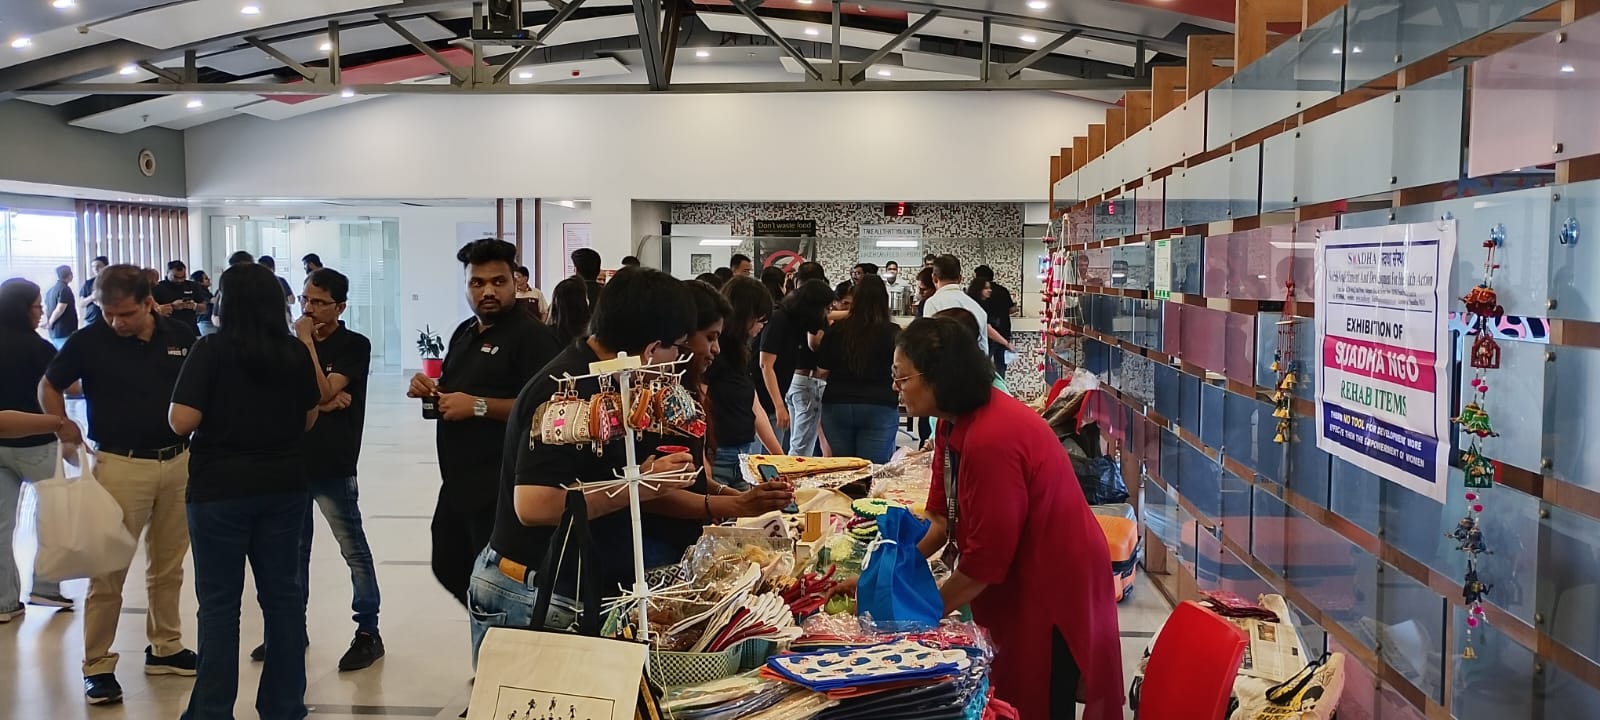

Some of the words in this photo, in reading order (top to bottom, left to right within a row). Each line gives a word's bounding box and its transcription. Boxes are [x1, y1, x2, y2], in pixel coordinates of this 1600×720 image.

[897, 206, 904, 216] 3
[1346, 317, 1391, 338] EXHIBITION
[1393, 324, 1403, 340] OF
[1387, 351, 1419, 382] NGO
[1340, 380, 1373, 406] REHAB
[1374, 388, 1407, 416] ITEMS
[1343, 413, 1351, 424] NO
[1351, 416, 1365, 429] TOOL
[1365, 423, 1377, 434] FOR
[1407, 438, 1422, 451] MORE
[1364, 437, 1399, 458] EMPOWERMENT
[1405, 451, 1425, 468] WOMEN
